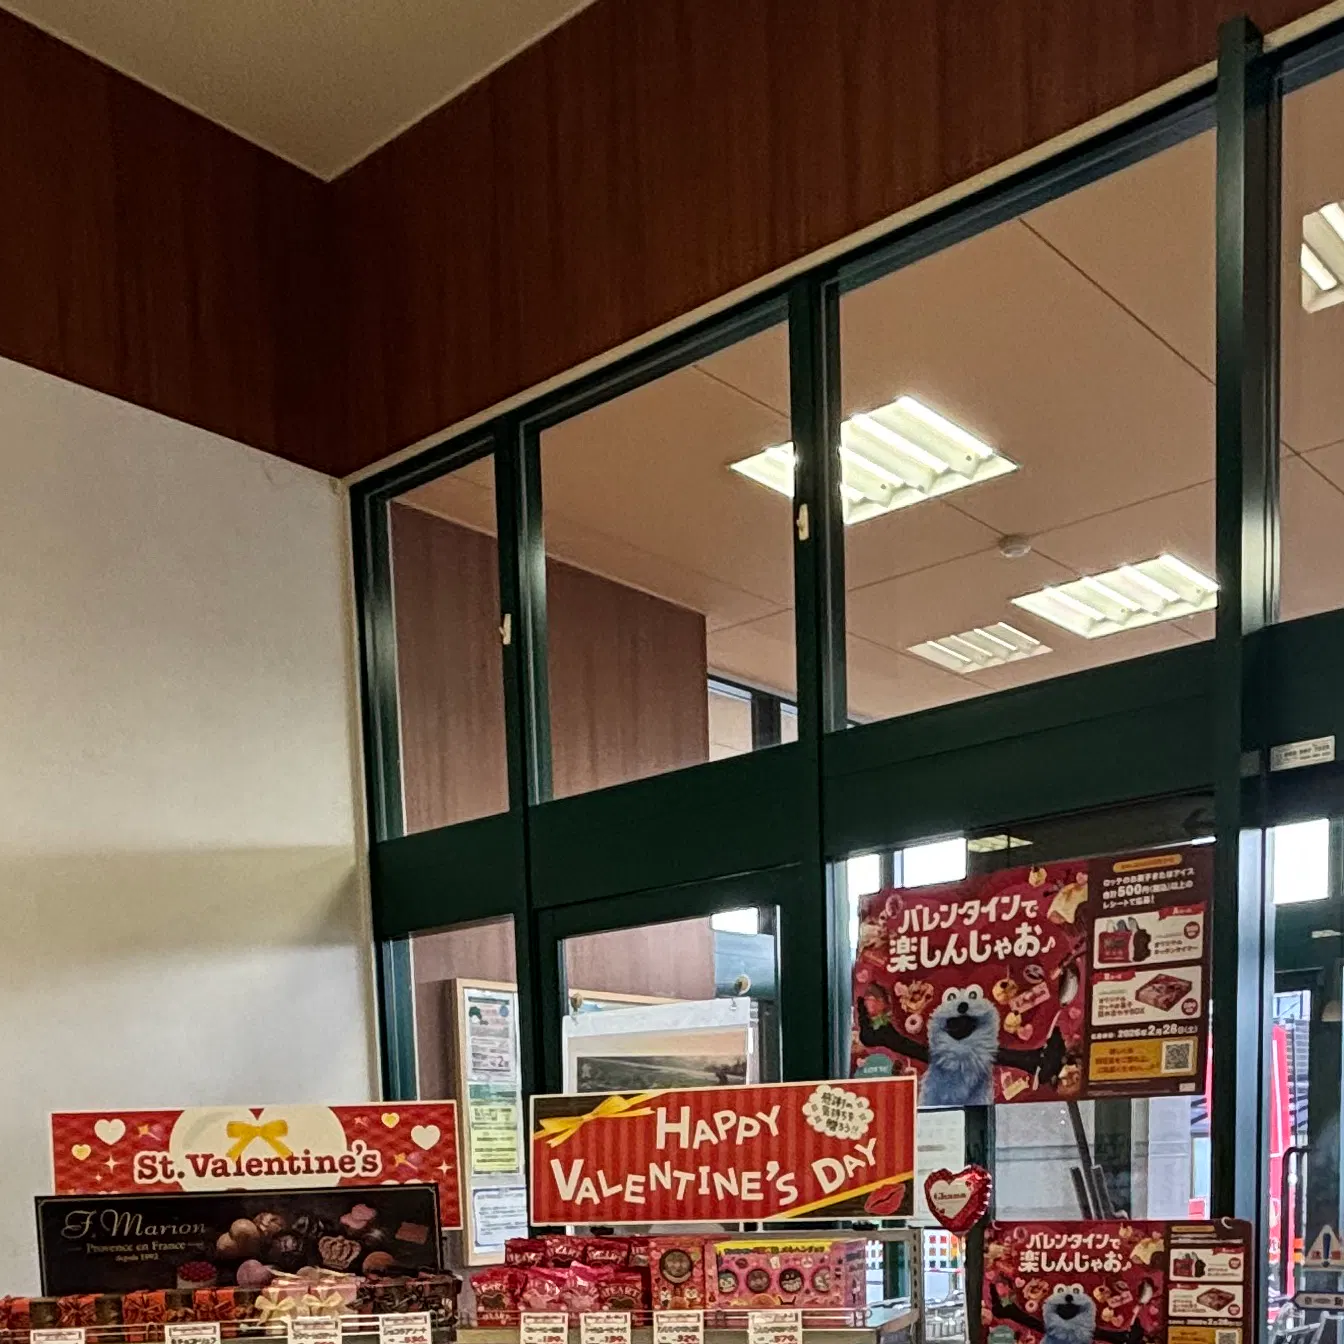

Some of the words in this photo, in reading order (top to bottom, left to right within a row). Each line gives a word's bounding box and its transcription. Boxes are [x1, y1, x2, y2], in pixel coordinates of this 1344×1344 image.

[898, 895, 1040, 935] バレンタインで
[656, 1104, 782, 1150] HAPPY
[550, 1156, 800, 1207] VALENTINE'S
[812, 1137, 878, 1195] DAY
[152, 1241, 187, 1251] France
[1026, 1232, 1121, 1250] バレンタインで
